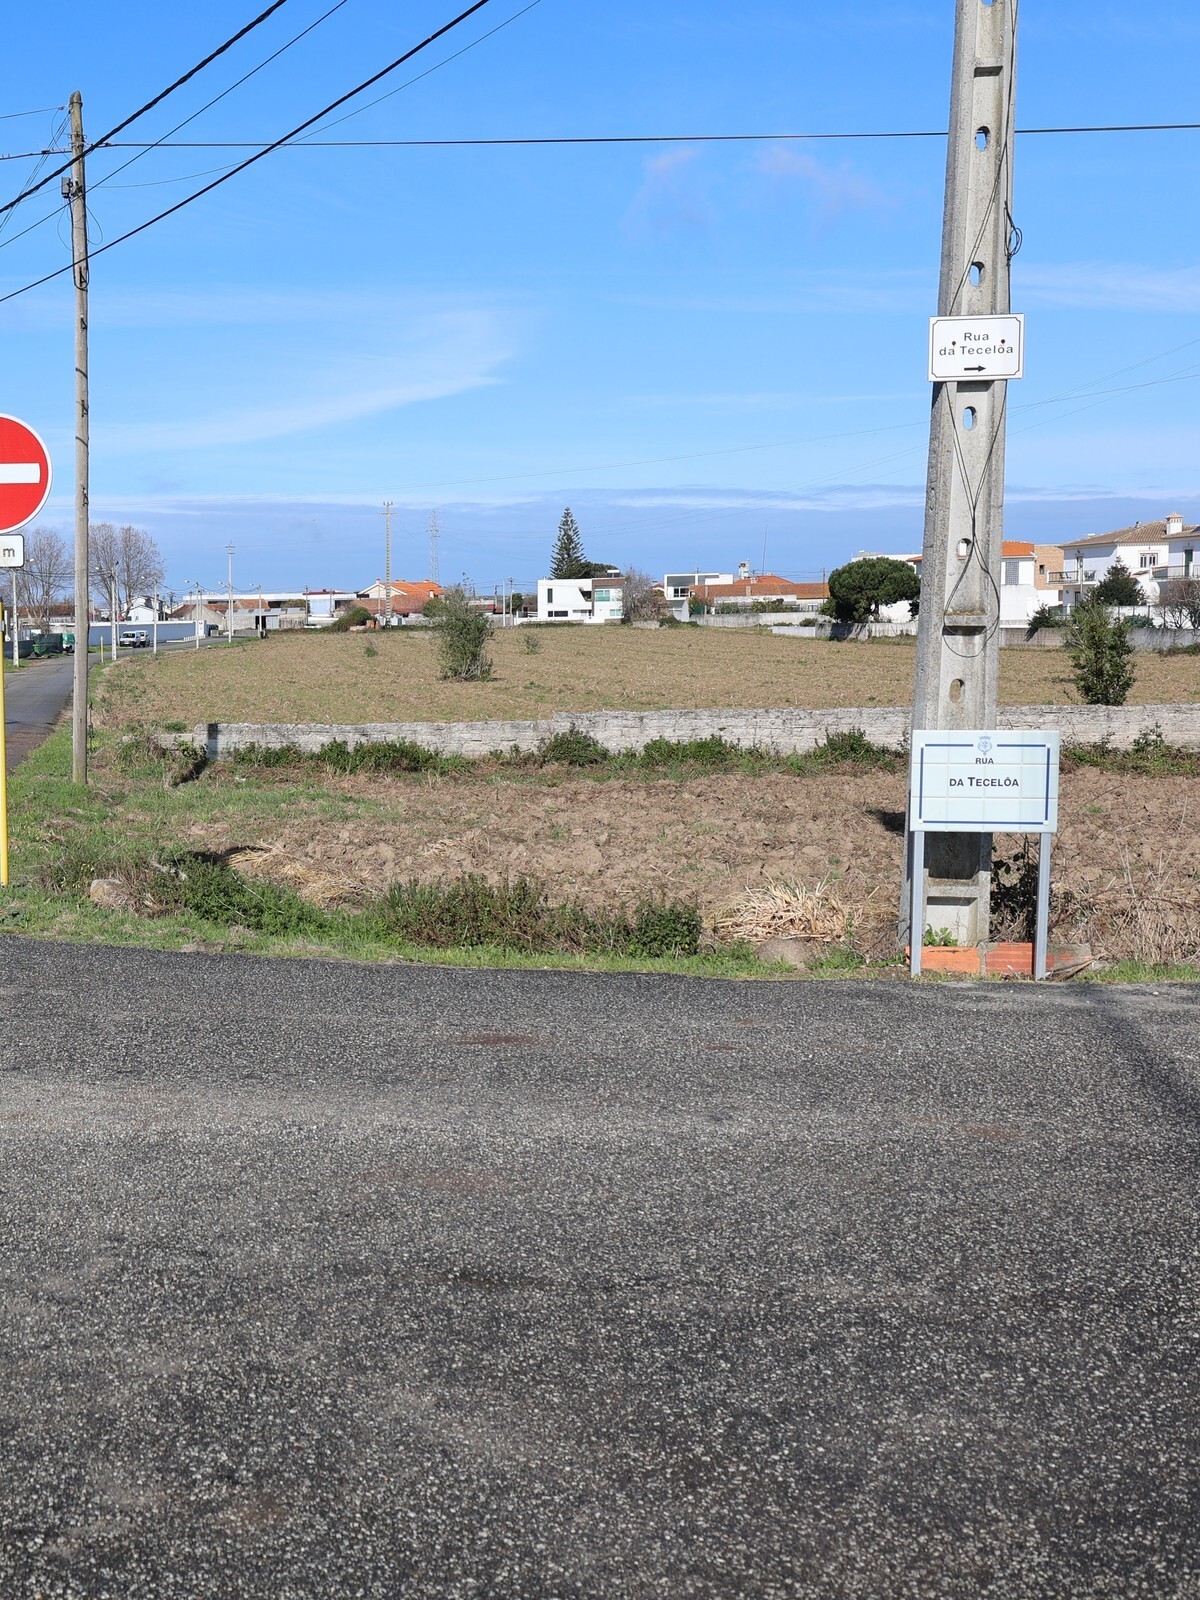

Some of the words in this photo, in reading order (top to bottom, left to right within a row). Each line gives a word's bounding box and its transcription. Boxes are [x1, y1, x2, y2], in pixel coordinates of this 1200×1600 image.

[964, 332, 989, 341] Rua
[939, 347, 955, 356] da
[3, 548, 15, 558] m
[975, 757, 994, 765] RUA
[949, 778, 964, 787] DA
